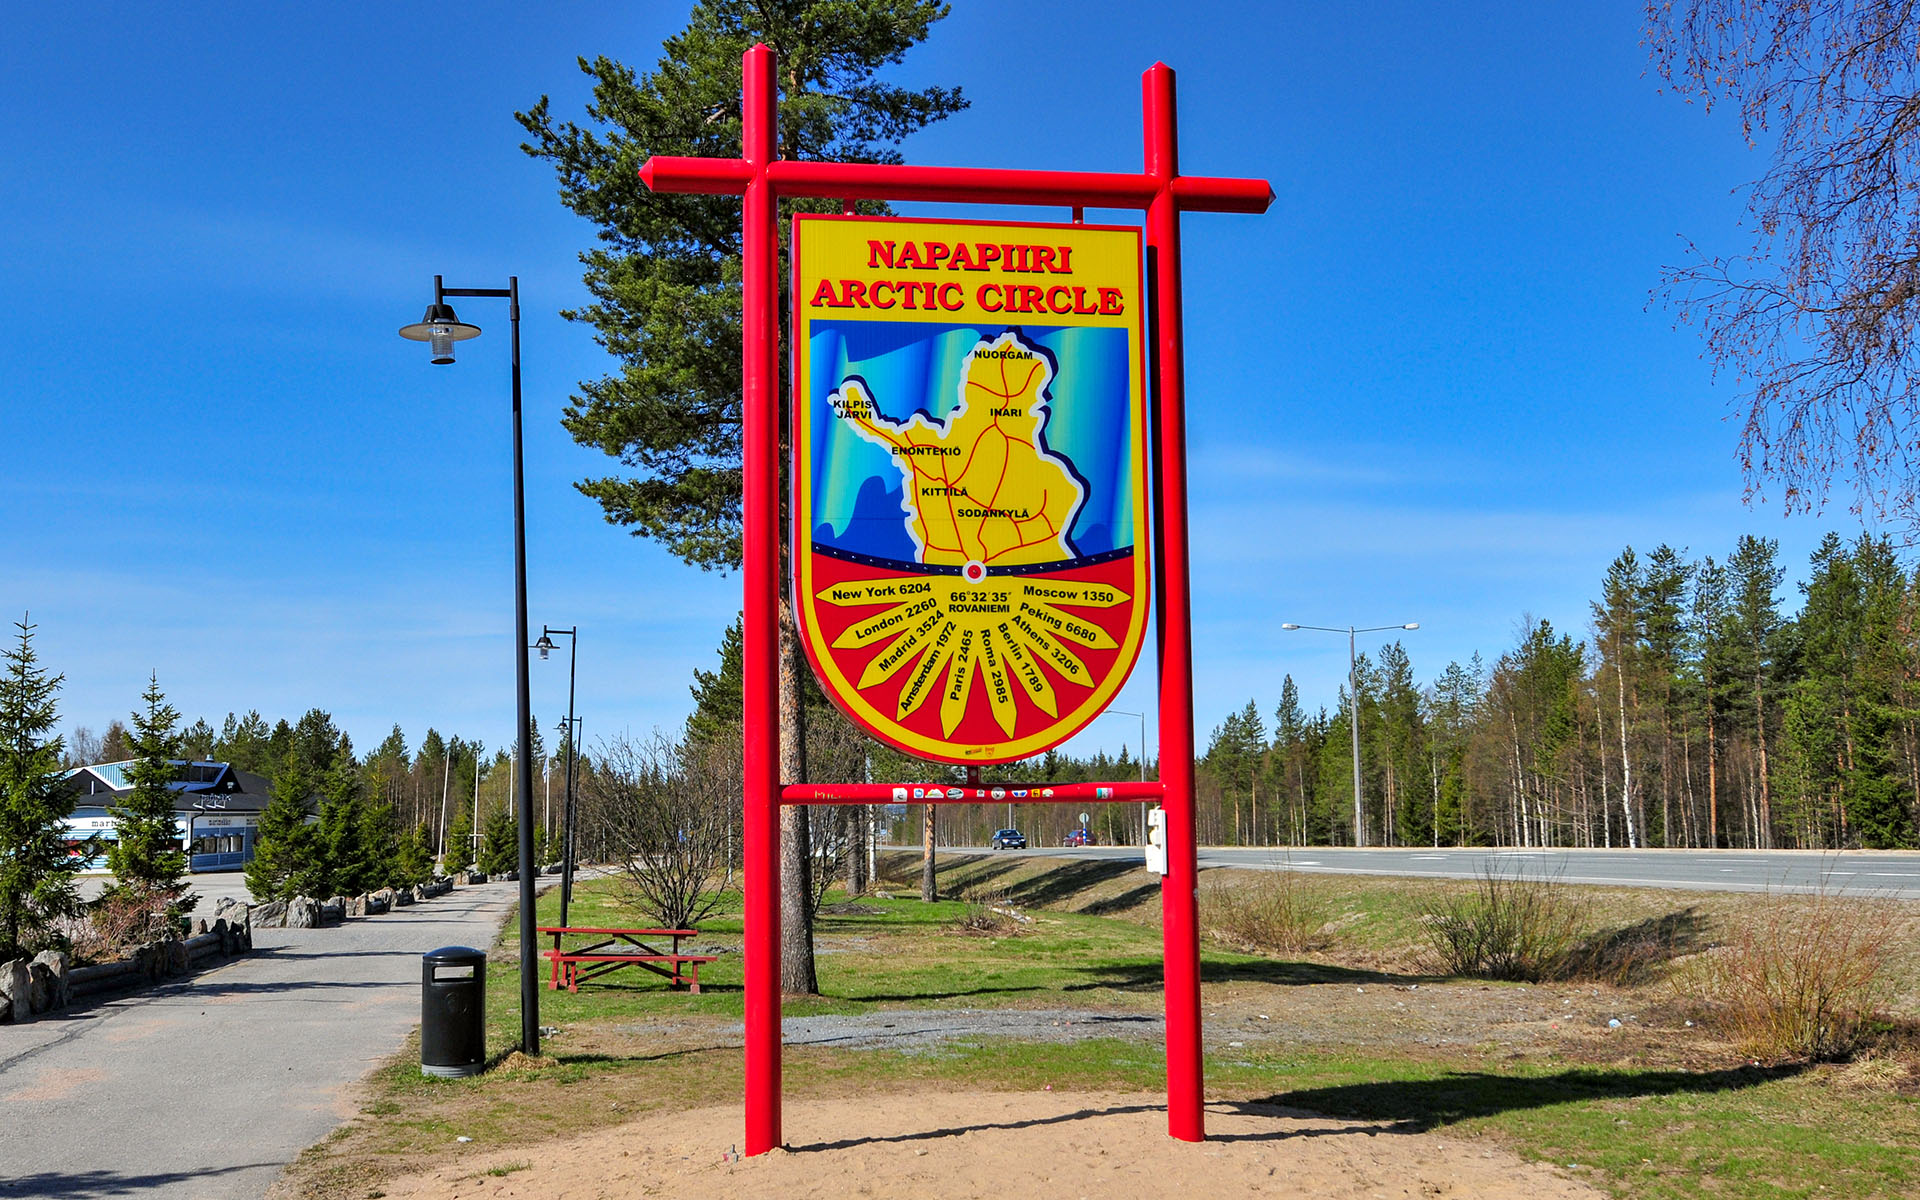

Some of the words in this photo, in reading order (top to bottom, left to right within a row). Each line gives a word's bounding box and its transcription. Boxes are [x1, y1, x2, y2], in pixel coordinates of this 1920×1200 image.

[867, 240, 1073, 274] NAPAPIIRI
[810, 279, 965, 312] ARCTIC
[976, 283, 1125, 316] CIRCLE
[974, 350, 1034, 360] NUORGAM
[833, 400, 873, 410] KILPIS
[990, 408, 1023, 418] INARI
[891, 445, 961, 457] ENONTEKIÖ
[922, 486, 969, 497] KITTILÄ
[957, 508, 1030, 519] SODANKYLÄ
[832, 589, 862, 601] New
[866, 585, 896, 598] York
[899, 582, 931, 595] 6204
[949, 604, 1010, 613] ROVANIEMI
[1023, 585, 1078, 600] Moscow
[1082, 590, 1114, 603] 1350
[855, 614, 903, 640] London
[905, 597, 937, 619] 2260
[1019, 602, 1063, 629] Peking
[1065, 622, 1097, 642] 6680
[878, 634, 918, 672] Madrid
[916, 609, 945, 637] 3524
[997, 622, 1023, 661] Berlin
[1021, 661, 1044, 693] 1789
[1011, 614, 1051, 651] Athens
[1051, 647, 1080, 676] 3206
[900, 649, 941, 712] Amsterdam
[936, 621, 957, 648] 1972
[950, 667, 966, 701] Paris
[958, 629, 974, 663] 2465
[980, 629, 996, 668] Roma
[991, 671, 1009, 704] 2985
